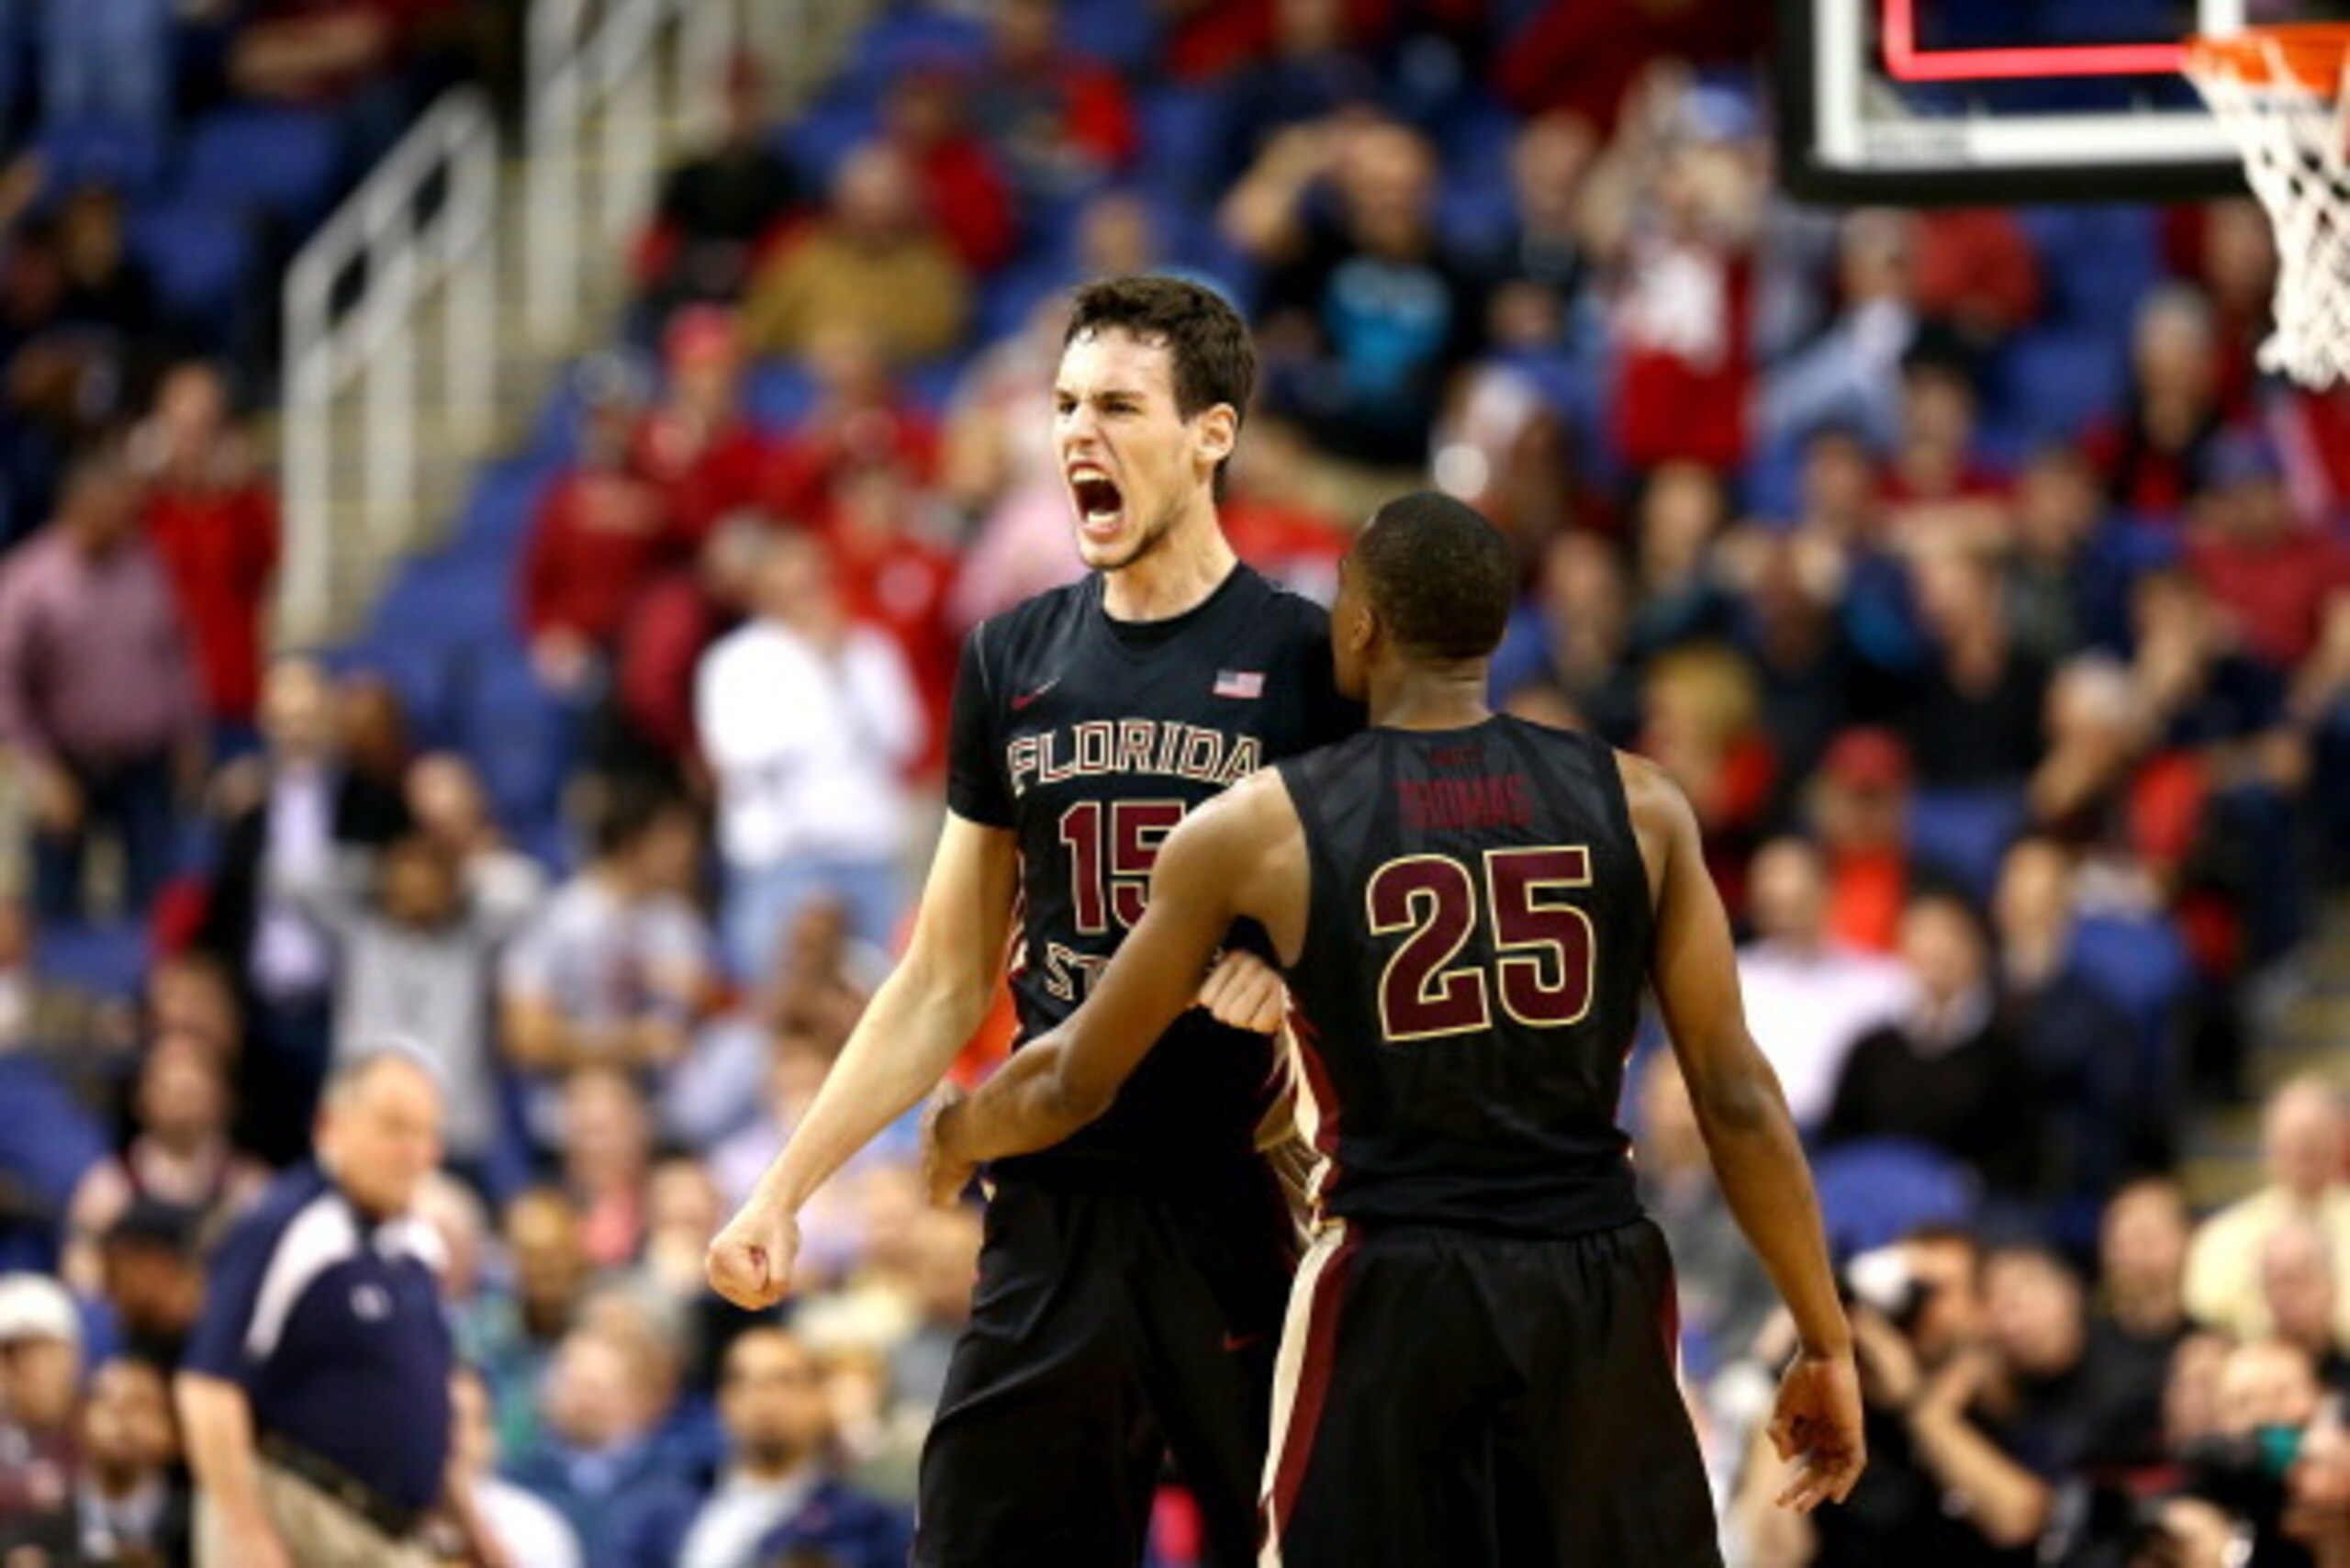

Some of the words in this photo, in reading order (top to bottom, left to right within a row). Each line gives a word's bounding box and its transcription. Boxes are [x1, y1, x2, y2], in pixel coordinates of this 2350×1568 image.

[1008, 719, 1263, 796] FLORIDA
[1059, 801, 1186, 935] 15
[1366, 845, 1595, 1040] 25
